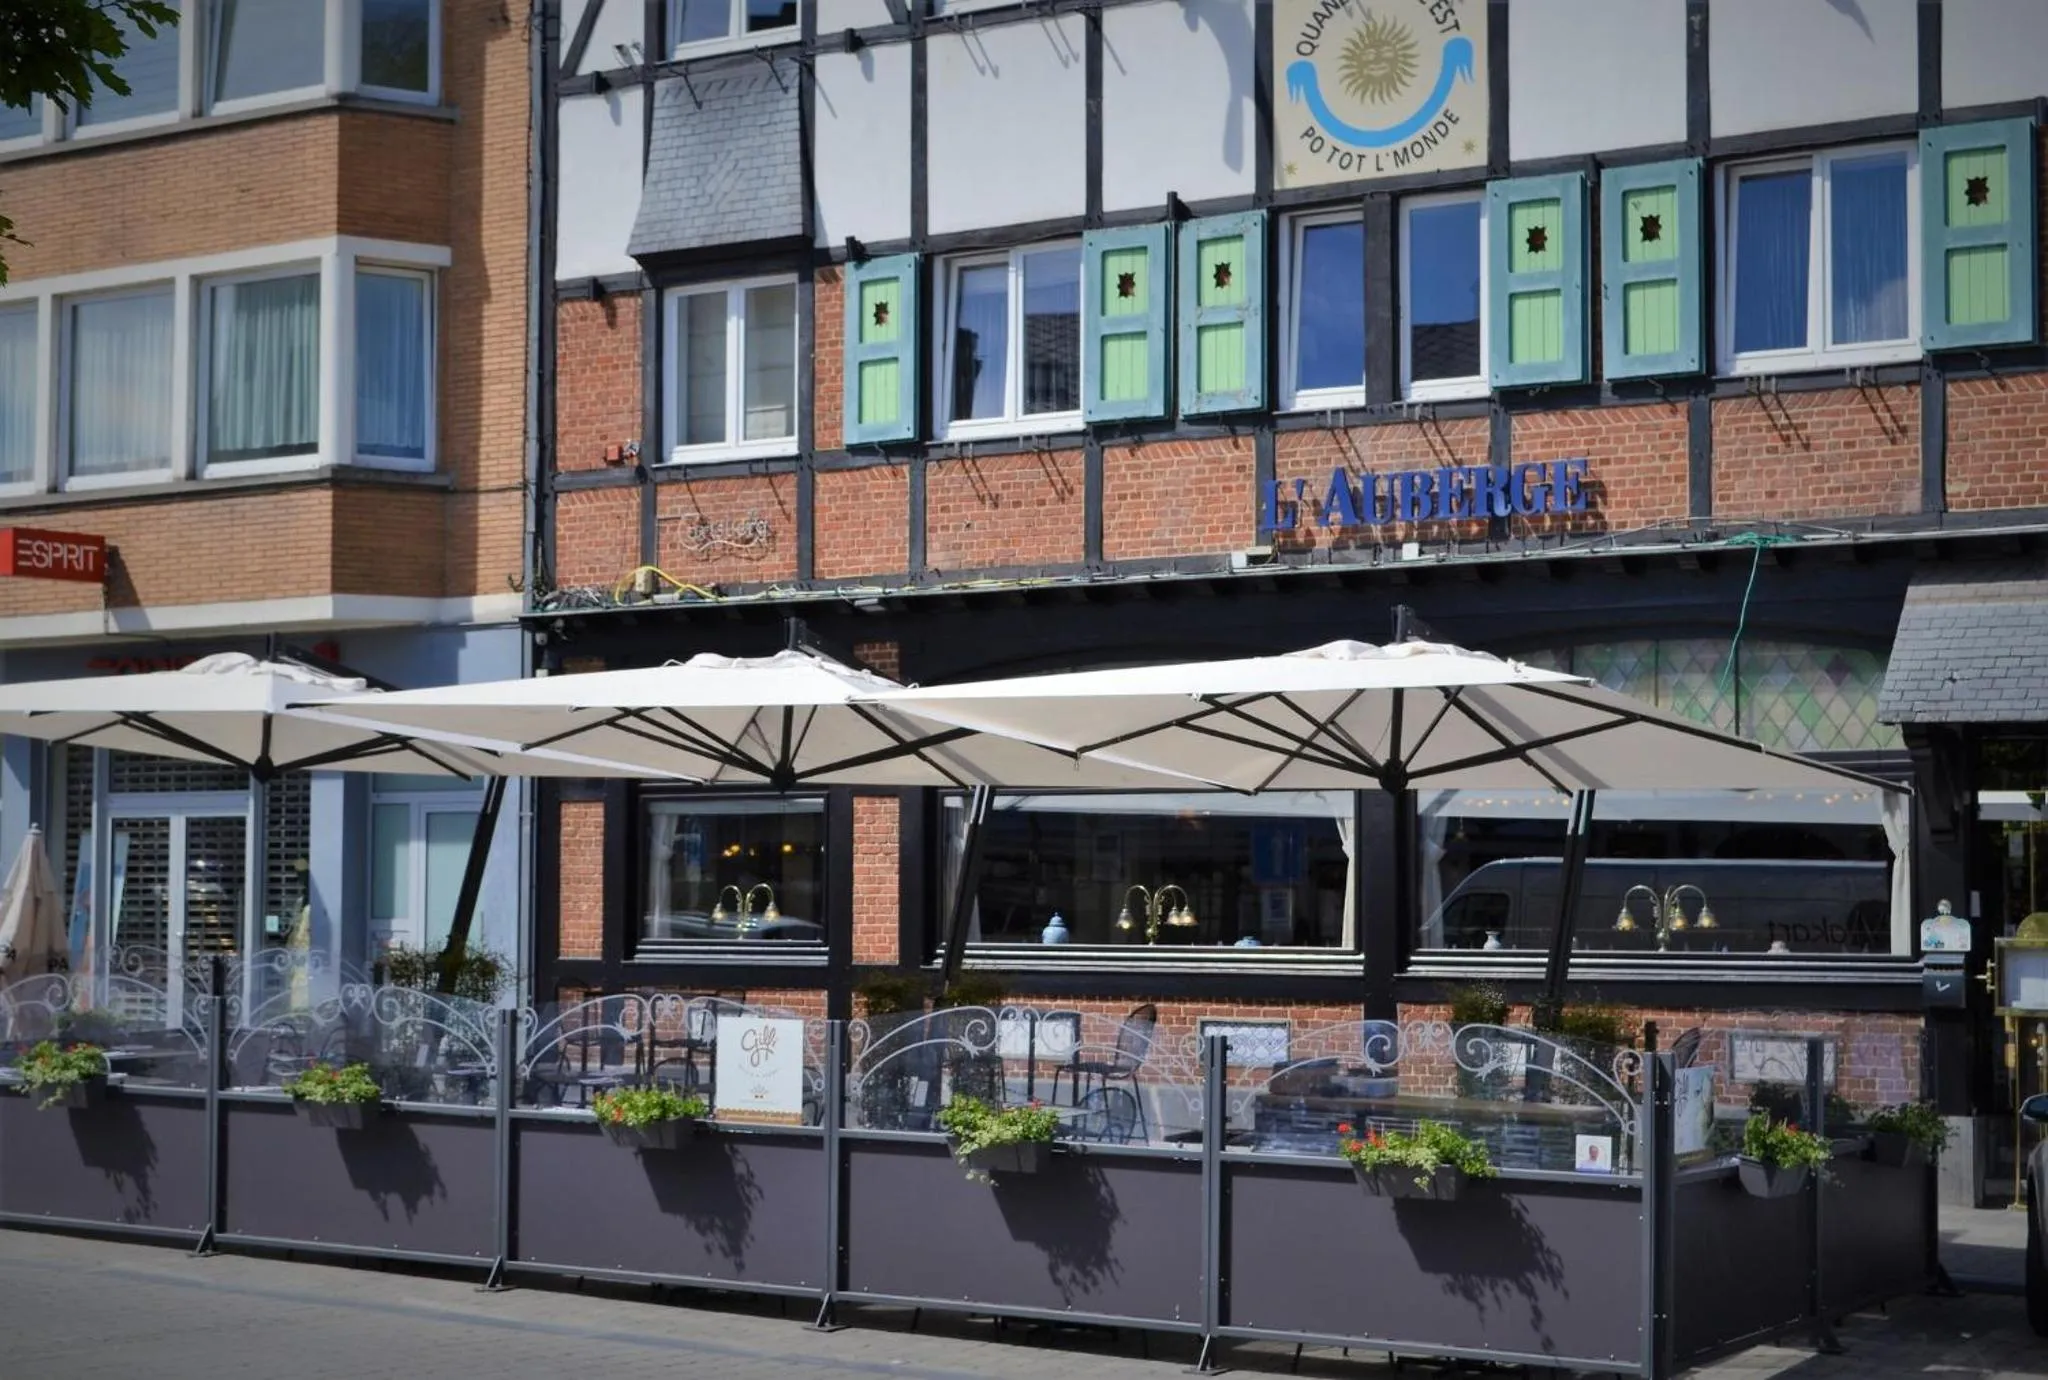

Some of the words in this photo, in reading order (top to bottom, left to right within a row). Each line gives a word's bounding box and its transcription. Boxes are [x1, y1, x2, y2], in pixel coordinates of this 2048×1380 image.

[1296, 0, 1349, 57] QUAN
[1299, 126, 1326, 154] PO
[1326, 146, 1368, 173] TOT
[1375, 108, 1460, 173] L'MONDE
[17, 538, 100, 572] ESPRIT
